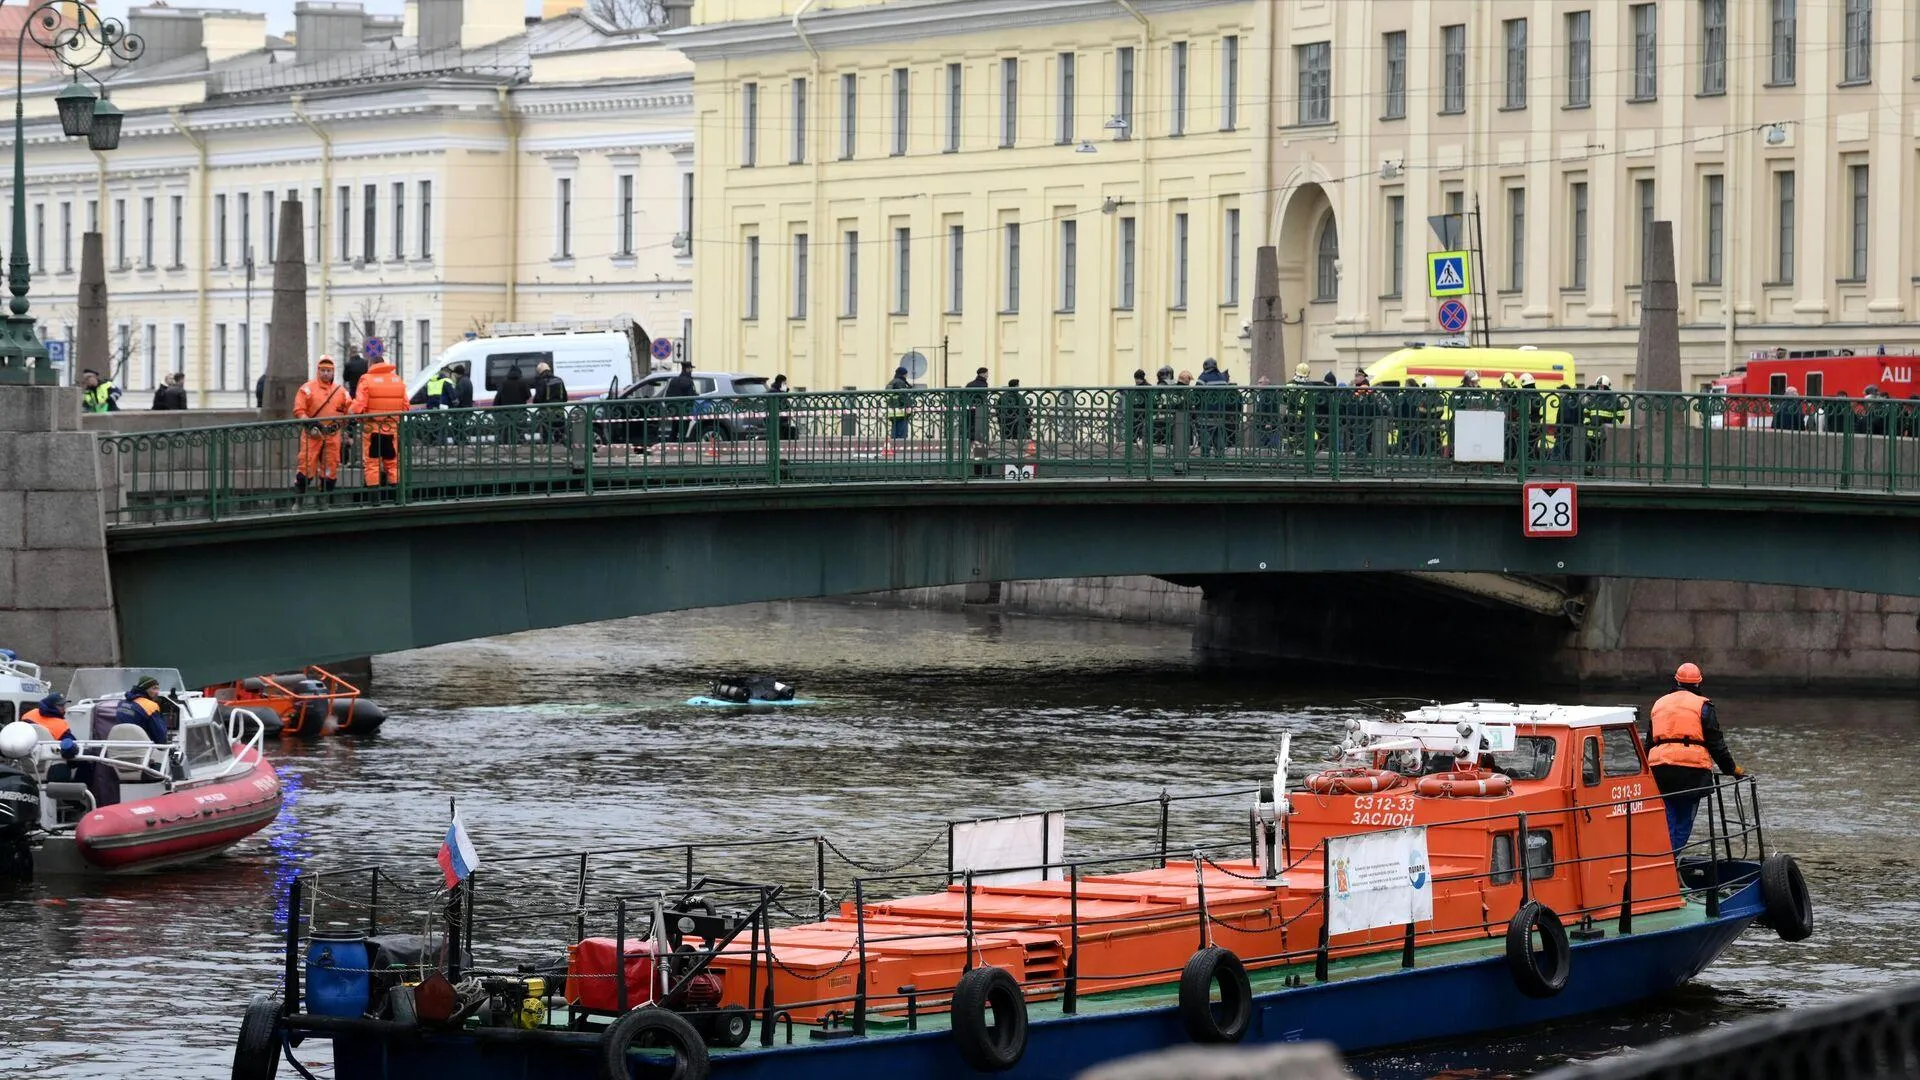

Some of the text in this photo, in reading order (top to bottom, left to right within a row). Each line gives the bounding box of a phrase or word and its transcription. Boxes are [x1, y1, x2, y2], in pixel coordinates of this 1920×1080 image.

[1880, 366, 1912, 383] АШ
[0, 790, 39, 806] MERCUR
[1351, 811, 1415, 827] ЗАСЛОН
